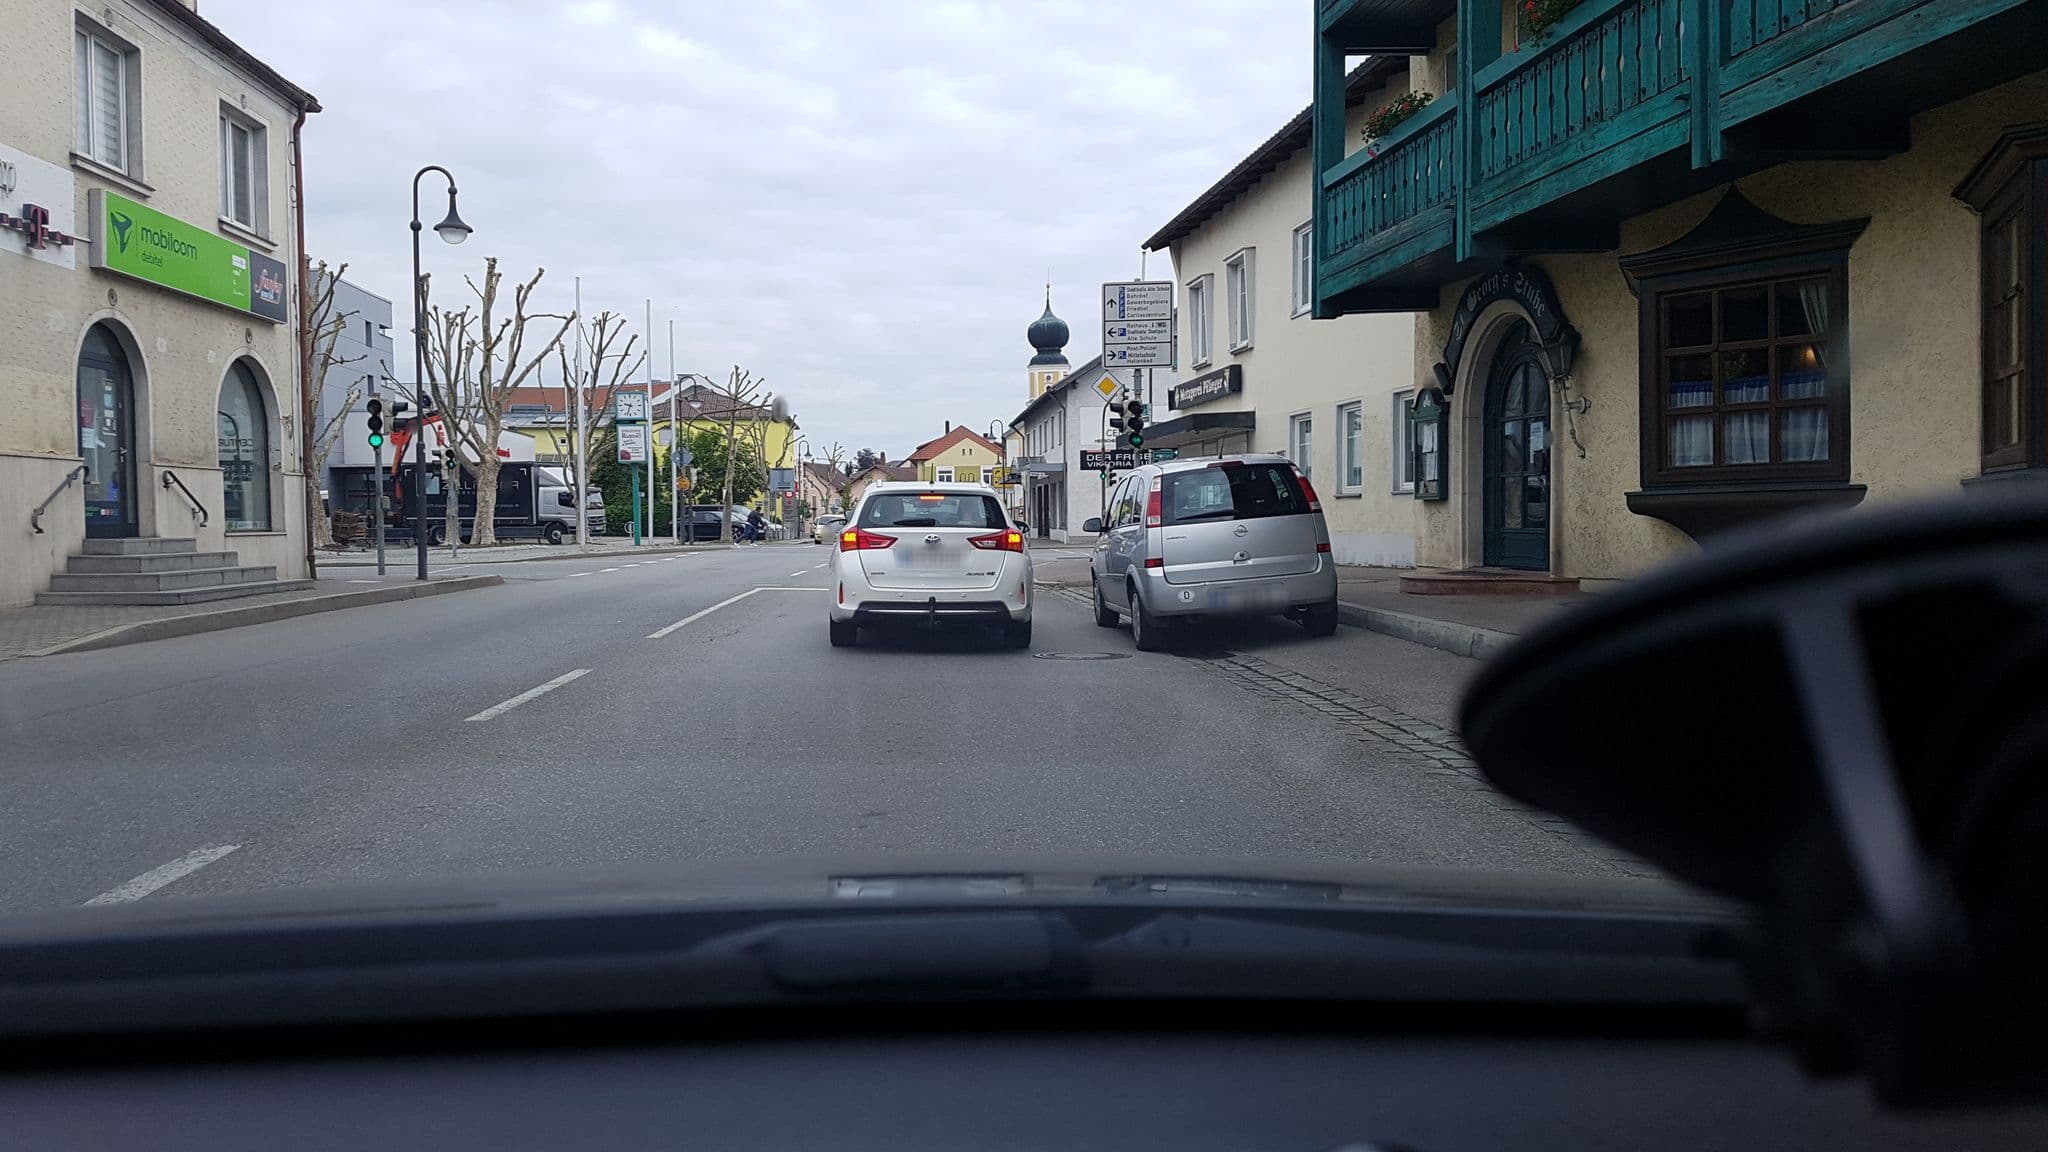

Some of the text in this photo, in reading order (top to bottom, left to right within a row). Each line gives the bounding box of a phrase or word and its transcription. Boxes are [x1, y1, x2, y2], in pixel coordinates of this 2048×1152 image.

[141, 226, 198, 261] mobilcom
[1514, 271, 1545, 318] Stube
[1179, 381, 1203, 402] Metzgerei
[1086, 453, 1112, 461] DER
